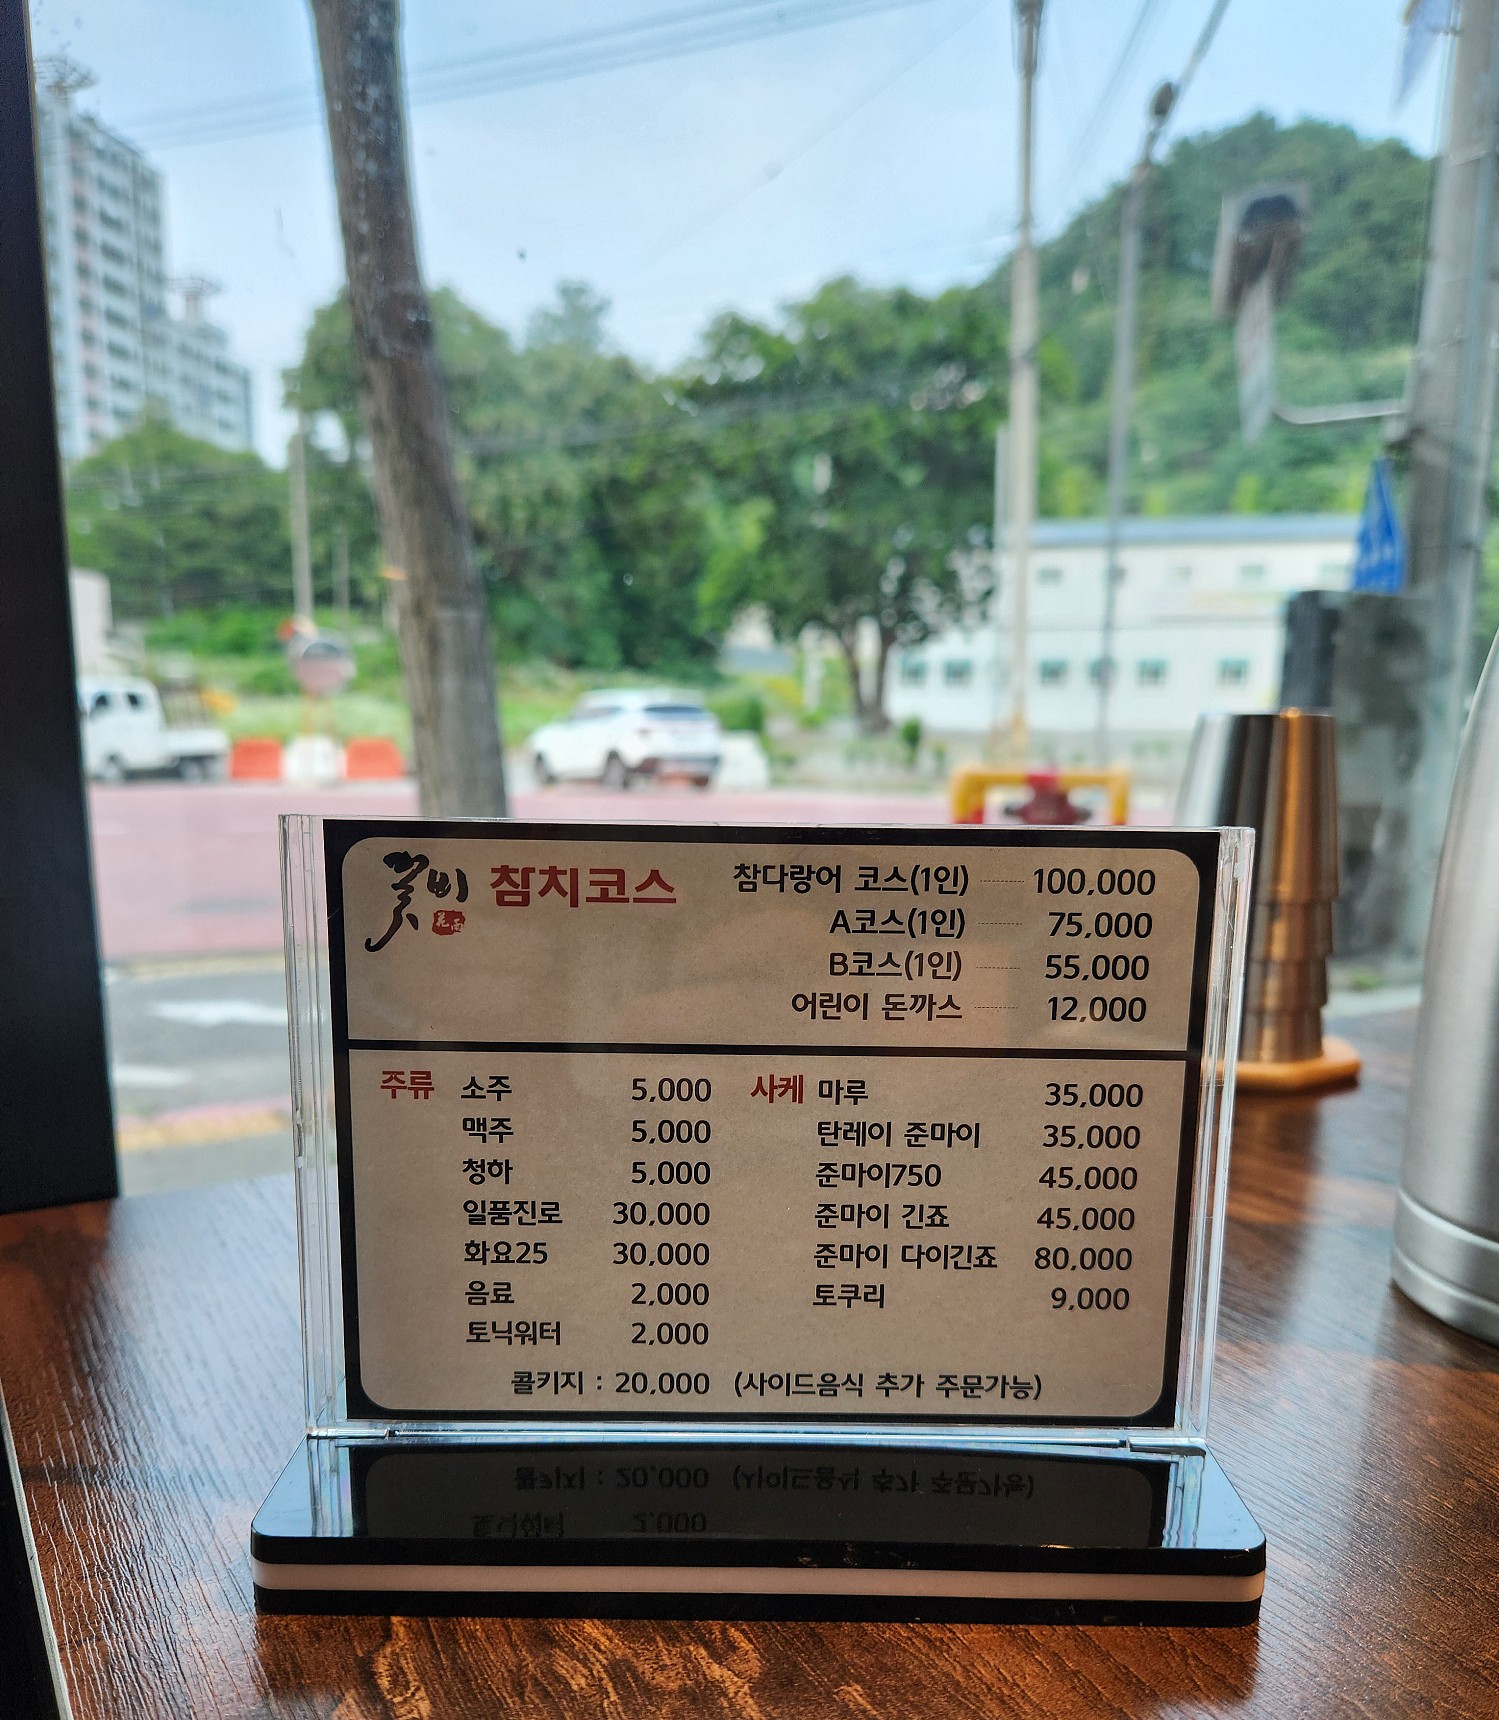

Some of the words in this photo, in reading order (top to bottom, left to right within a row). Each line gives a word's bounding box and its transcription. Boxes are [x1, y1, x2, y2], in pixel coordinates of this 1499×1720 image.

[489, 864, 677, 908] 참치코스
[732, 862, 842, 895] 참다랑어
[854, 864, 969, 897] 코스(1인)
[1033, 867, 1156, 896] 100,000
[828, 907, 966, 940] A코스(1인)
[1048, 911, 1153, 939] 75,000
[829, 950, 962, 982] B코스(1인)
[1044, 954, 1150, 981] 55,000
[791, 992, 869, 1021] 어린이
[881, 993, 963, 1022] 돈까스
[1047, 996, 1147, 1023] 12,000
[380, 1070, 435, 1100] 주류
[460, 1075, 513, 1102] 소주
[631, 1077, 712, 1103] 5,000
[750, 1073, 804, 1105] 사케
[818, 1079, 869, 1106] 마루
[1044, 1082, 1144, 1108] 35,000
[462, 1117, 514, 1144] 맥주
[631, 1119, 712, 1145] 5,000
[817, 1120, 892, 1148] 탄레이
[903, 1122, 980, 1149] 준마이
[1042, 1124, 1141, 1150] 35,000
[461, 1158, 514, 1186] 청하
[630, 1160, 711, 1186] 5,000
[815, 1162, 942, 1189] 준마이750
[1038, 1166, 1138, 1191] 45,000
[462, 1199, 563, 1226] 일품진로
[612, 1201, 711, 1227] 30,000
[814, 1203, 890, 1229] 준마이
[901, 1203, 950, 1230] 긴죠
[1036, 1207, 1135, 1231] 45,000
[463, 1239, 548, 1266] 화요25
[612, 1242, 710, 1267] 30,000
[813, 1243, 888, 1269] 준마이
[901, 1244, 998, 1271] 다이긴죠
[1034, 1246, 1133, 1271] 80,000
[464, 1280, 515, 1306] 음료
[631, 1282, 710, 1307] 2,000
[812, 1283, 885, 1309] 토쿠리
[1050, 1287, 1130, 1311] 9,000
[465, 1320, 561, 1346] 토닉워터
[631, 1322, 709, 1346] 2,000
[510, 1370, 584, 1396] 콜키지
[615, 1371, 710, 1395] 20,000
[734, 1371, 864, 1398] (사이드음식
[875, 1372, 925, 1398] 추가
[935, 1374, 1042, 1401] 주문가능)
